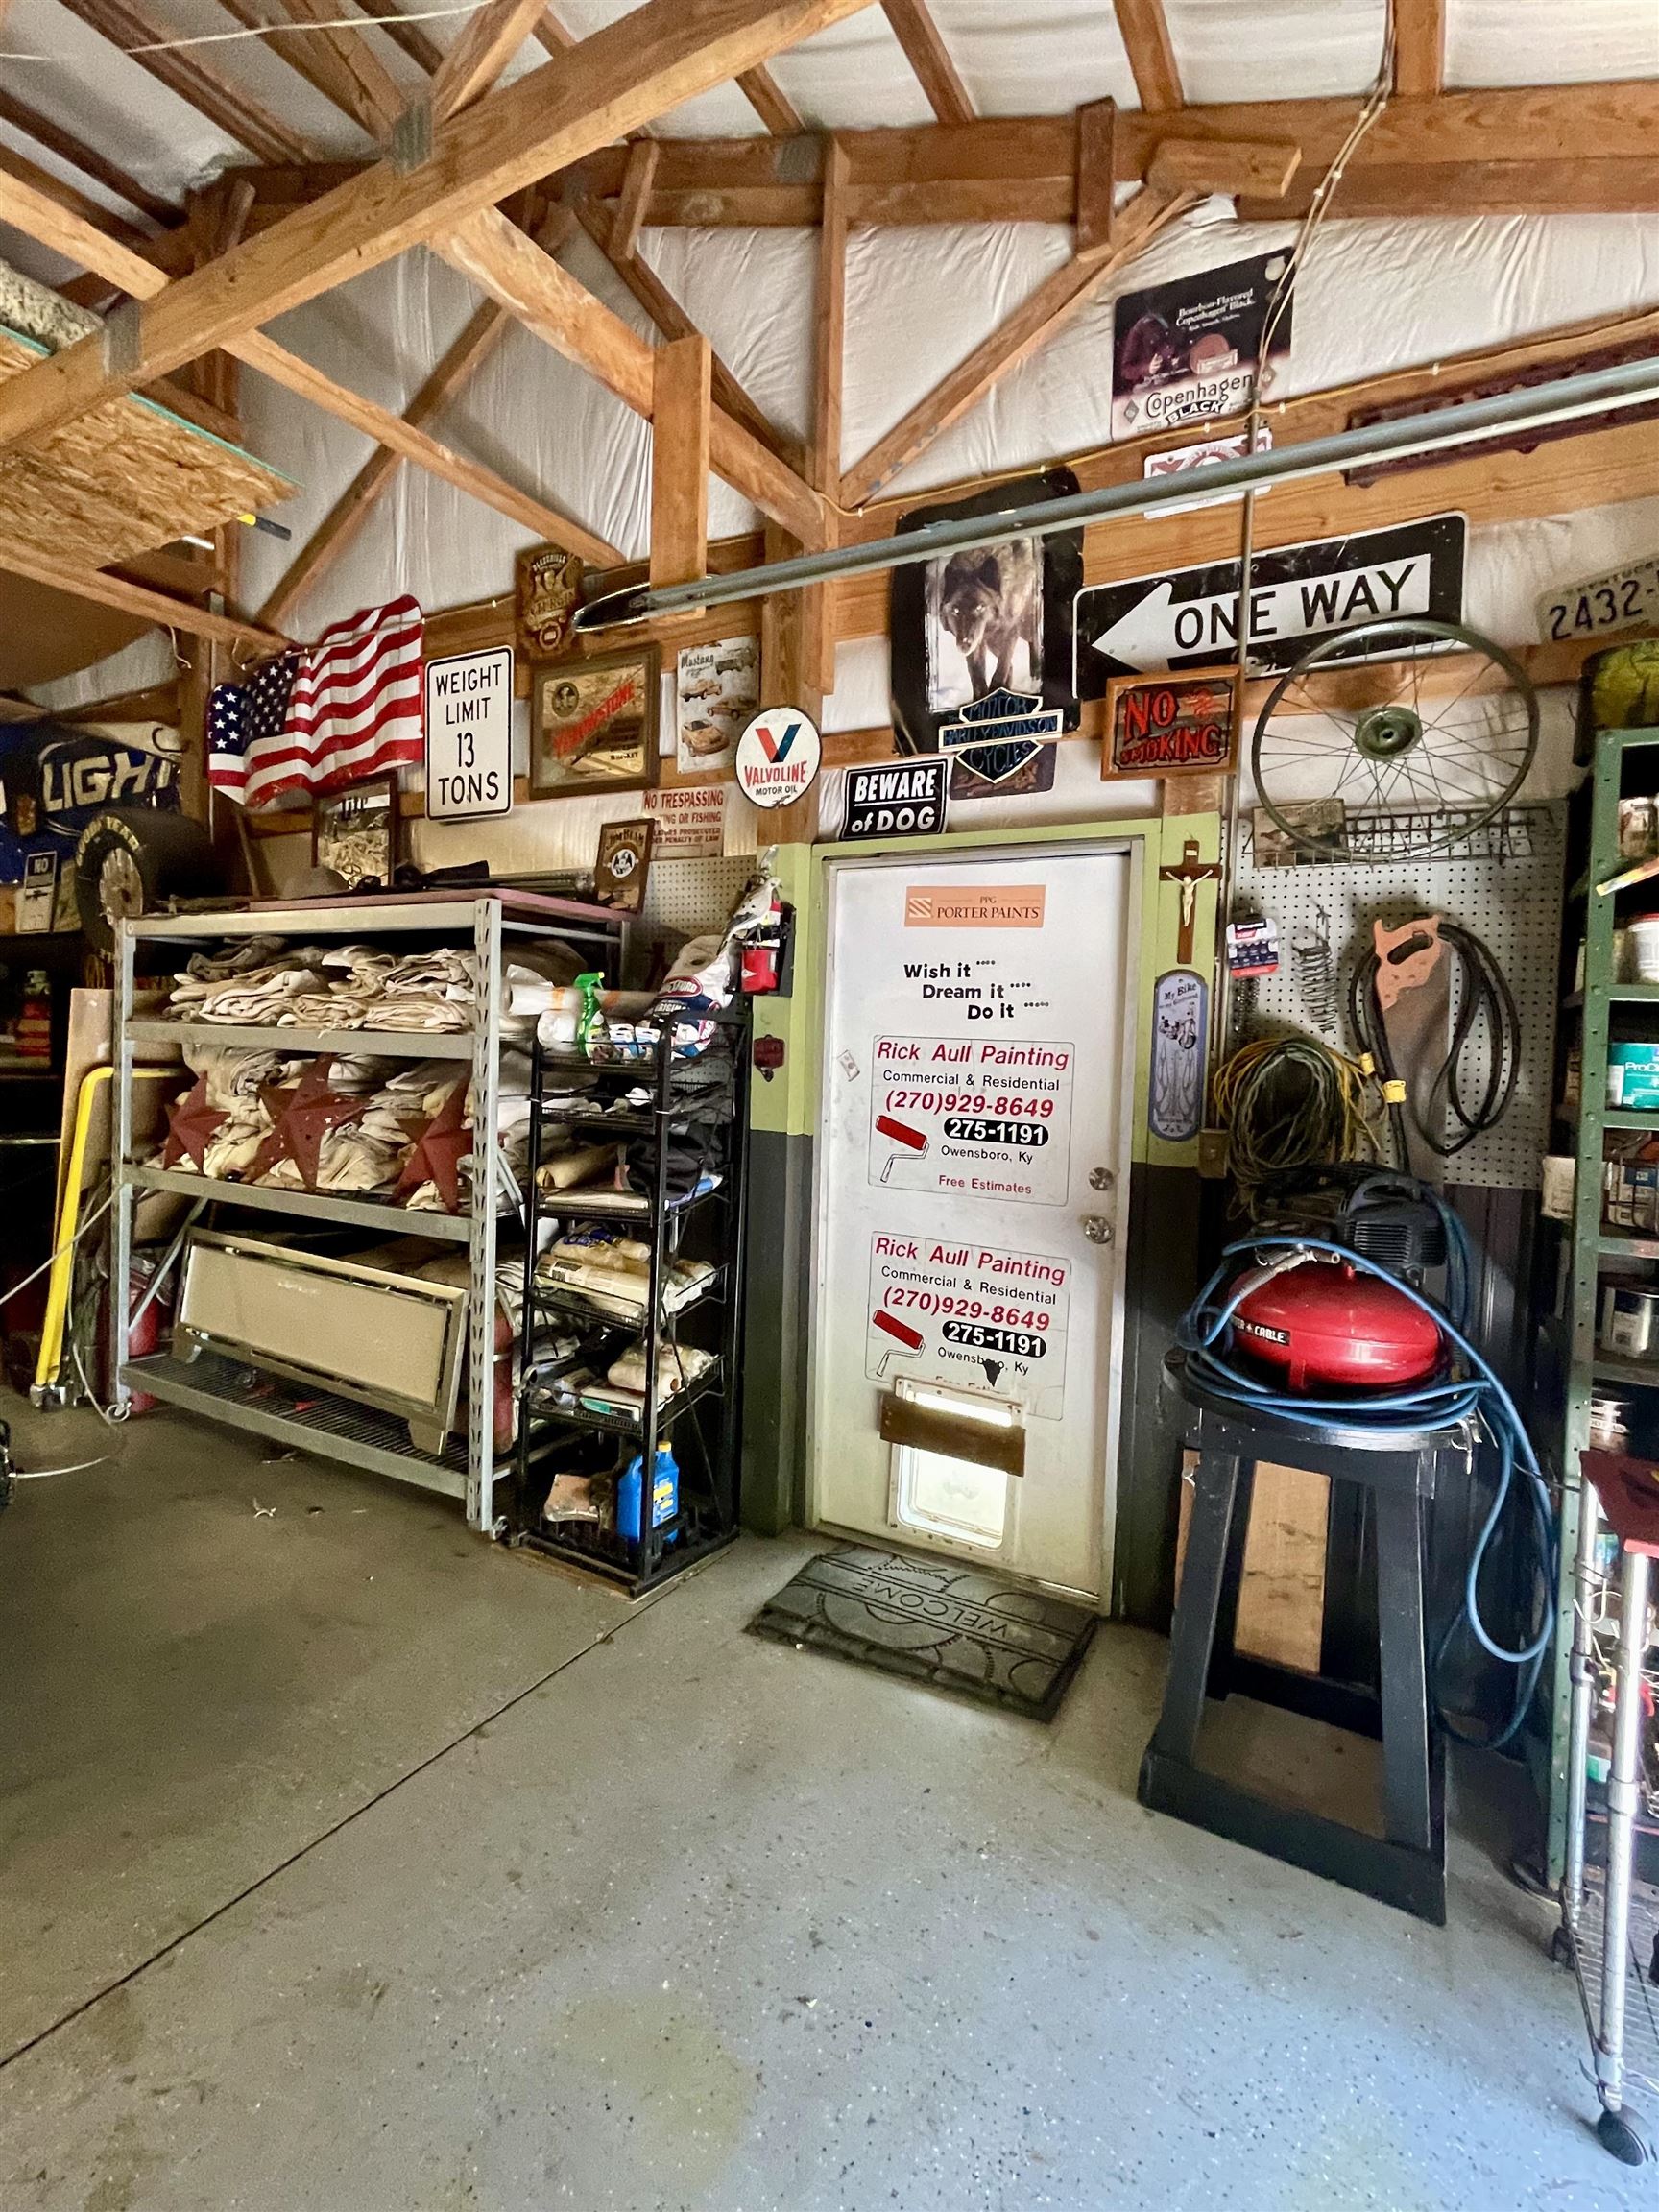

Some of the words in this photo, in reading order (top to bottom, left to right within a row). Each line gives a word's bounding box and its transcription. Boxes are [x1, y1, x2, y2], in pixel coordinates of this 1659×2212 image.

[1146, 374, 1253, 419] Copenhagen
[1166, 400, 1223, 423] BLACK
[1174, 590, 1278, 650] ONE
[1300, 564, 1417, 629] WAY
[1549, 569, 1659, 641] 2432-
[681, 654, 714, 669] Mustang
[436, 664, 502, 696] WEIGHT
[445, 697, 491, 725] LIMIT
[969, 695, 1027, 722] MOTOR
[1124, 690, 1179, 746] NO
[457, 732, 474, 768] 13
[969, 740, 1032, 774] CYCLES
[1119, 724, 1221, 764] SMOKING
[744, 760, 807, 787] VALVOLINE
[854, 768, 937, 802] BEWARE
[438, 771, 499, 805] TONS
[644, 790, 657, 809] NO
[661, 789, 723, 809] TRESPASSING
[756, 786, 782, 796] MOTOR
[784, 785, 798, 794] OIL
[679, 813, 689, 824] OR
[692, 811, 722, 823] FISHING
[851, 812, 874, 833] of
[876, 806, 935, 831] DOG
[937, 906, 988, 919] PORTER
[991, 906, 1040, 919] PAINTS
[979, 896, 997, 904] PPG
[904, 963, 950, 978] Wish
[957, 962, 971, 977] it
[923, 984, 982, 998] Dream
[990, 983, 1004, 998] it
[1177, 983, 1196, 996] Bike
[967, 1004, 994, 1019] Do
[878, 1042, 921, 1060] Rick
[931, 1044, 972, 1062] Aull
[980, 1045, 1070, 1070] Painting
[883, 1070, 959, 1085] Commercial
[966, 1074, 974, 1086] &
[982, 1075, 1060, 1091] Residential
[885, 1090, 1054, 1118] (270)929-8649
[949, 1118, 1044, 1145] 275-1191
[941, 1145, 1013, 1162] Owensboro,
[1019, 1151, 1033, 1165] Ky
[939, 1175, 965, 1188] Free
[972, 1178, 1032, 1194] Estimates
[875, 1237, 918, 1260] Rick
[929, 1245, 969, 1267] Aull
[977, 1252, 1066, 1286] Painting
[881, 1265, 956, 1288] Commercial
[963, 1279, 973, 1291] &
[979, 1282, 1056, 1305] Residential
[883, 1286, 1050, 1331] (270)929-8649
[947, 1322, 1042, 1357] 275-1191
[1254, 1325, 1286, 1343] CABLE
[937, 1347, 1009, 1371] Owensbo,
[1014, 1361, 1028, 1376] Ky
[852, 1577, 1009, 1638] WELCOME
